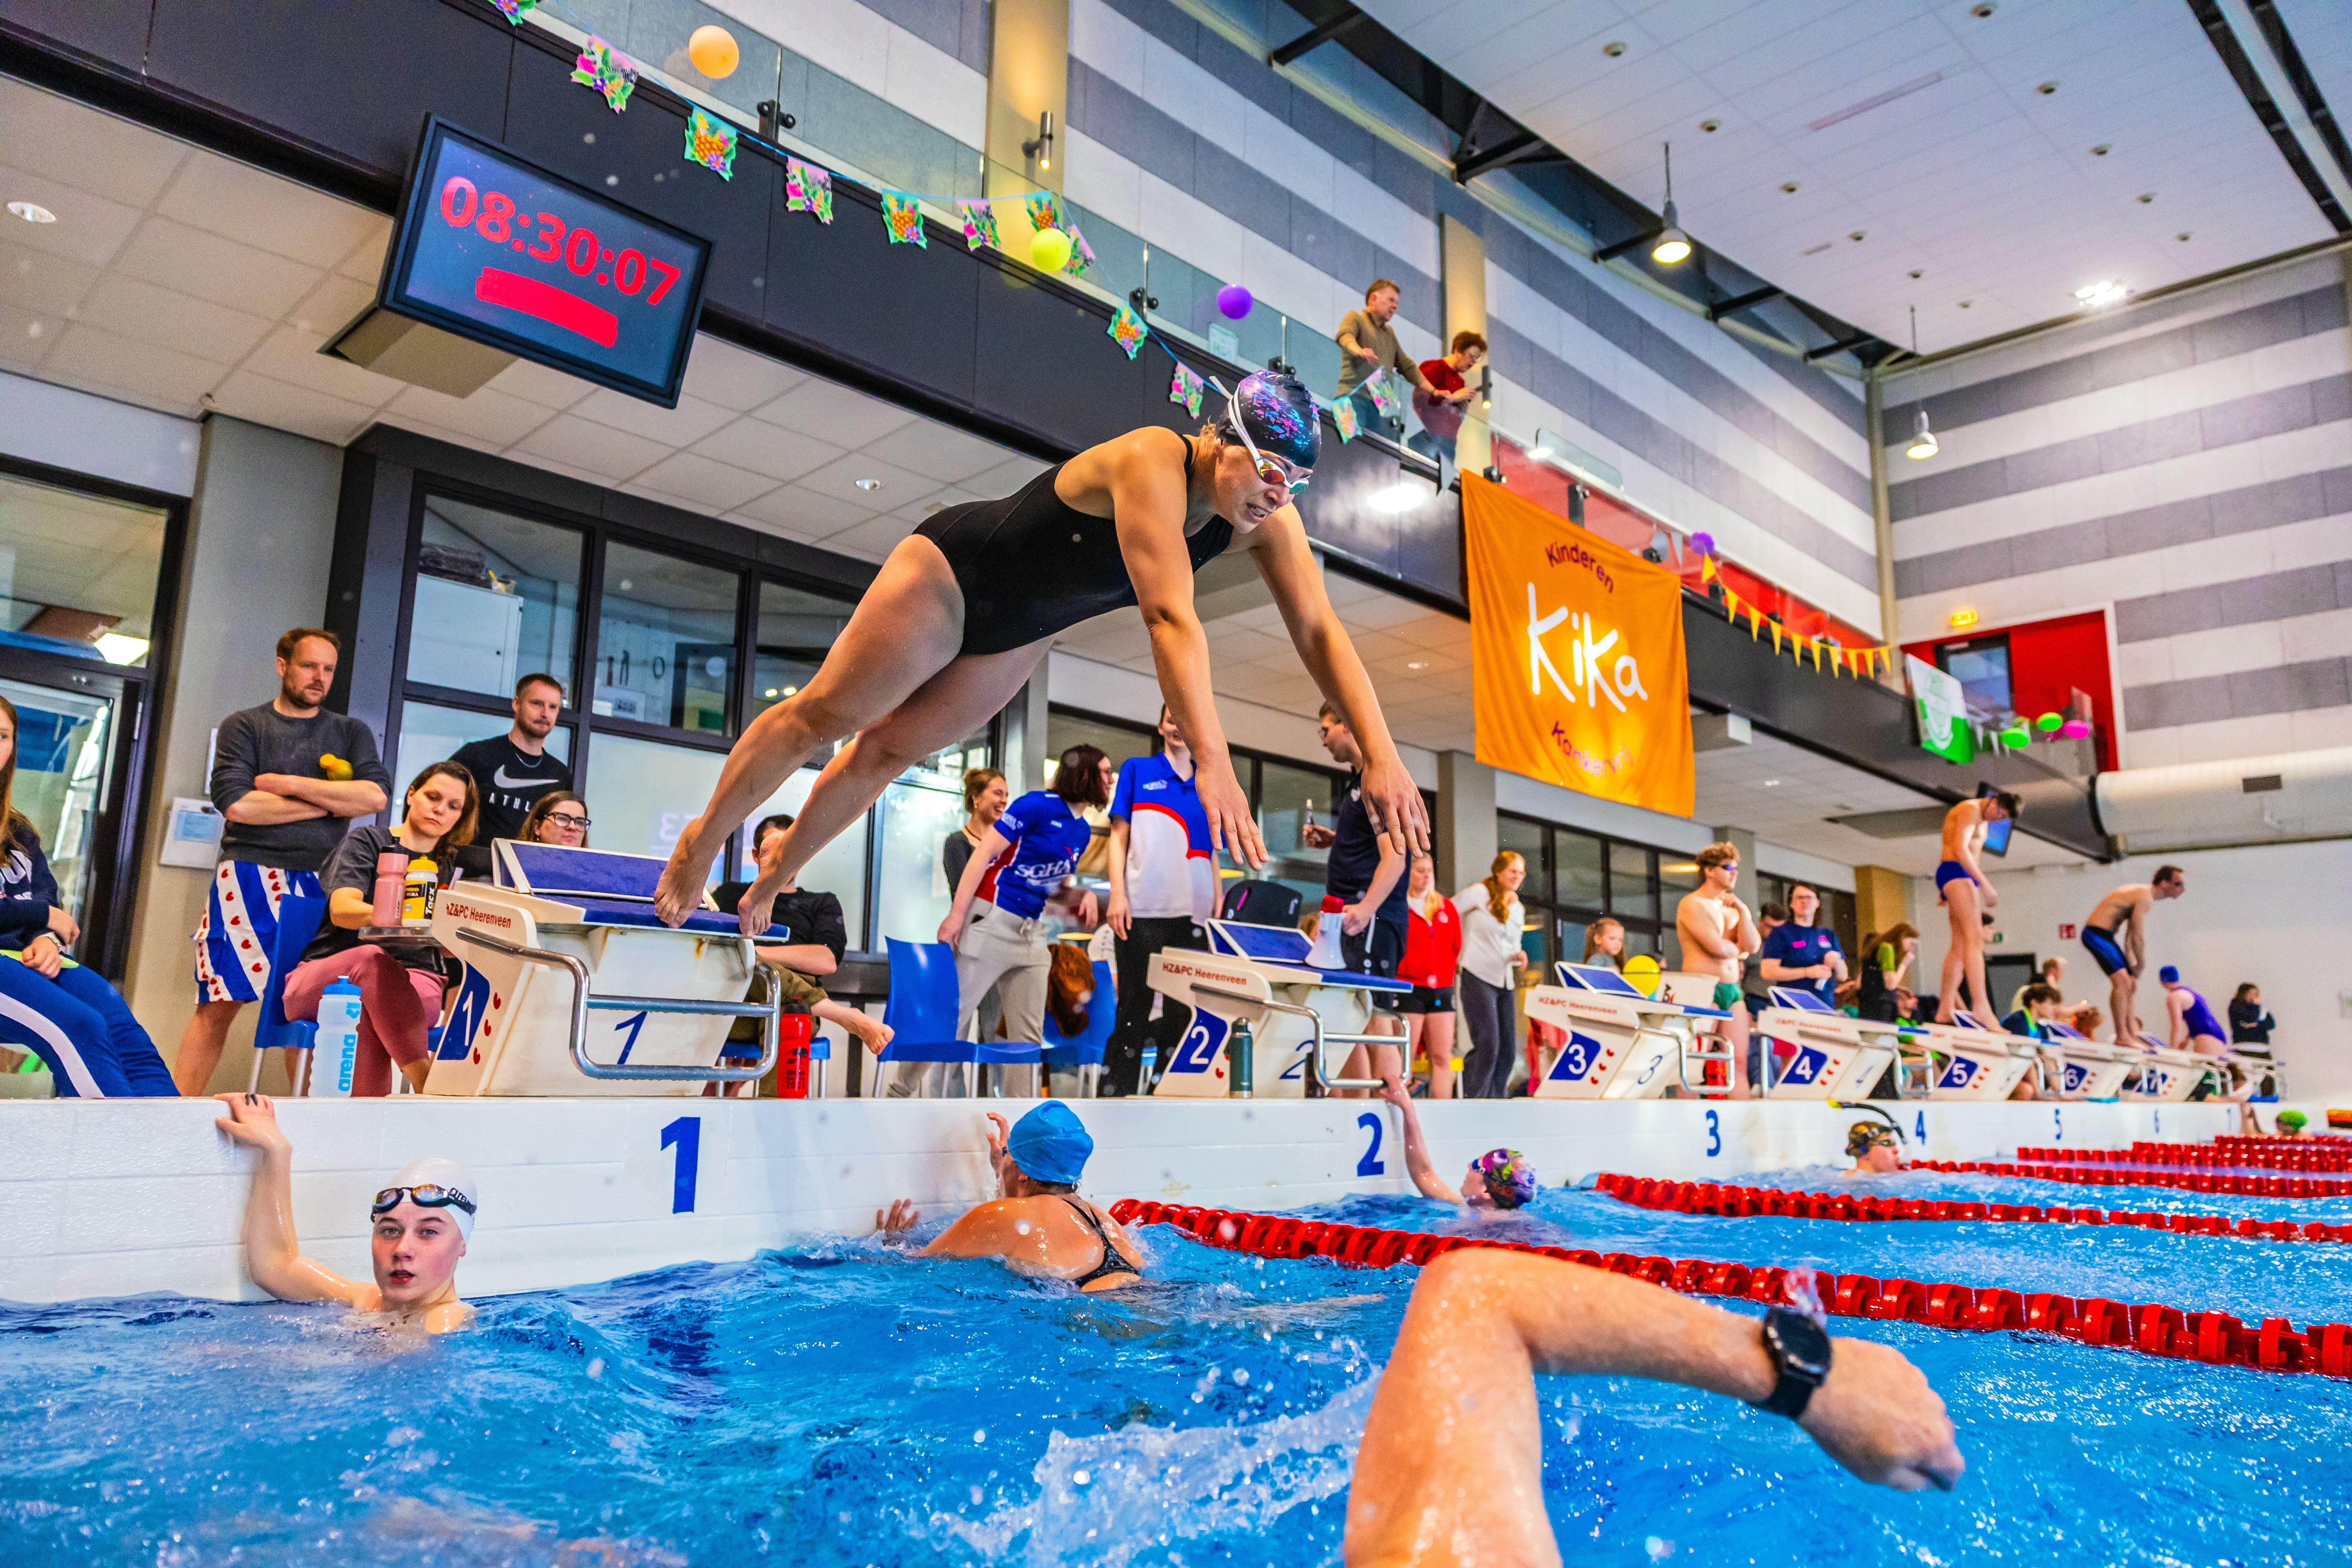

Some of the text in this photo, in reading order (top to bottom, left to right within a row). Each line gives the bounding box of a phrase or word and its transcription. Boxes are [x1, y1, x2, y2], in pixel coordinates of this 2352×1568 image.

[441, 176, 681, 305] 08:30:07
[1545, 541, 1614, 593] Kinderen
[1551, 720, 1634, 777] Kankervrij
[425, 887, 435, 915] Tacx
[470, 907, 511, 929] Heerenveen
[1163, 963, 1246, 985] HZ&PC Heerenveen
[463, 991, 474, 1046] 1
[614, 1011, 647, 1065] 1
[1190, 1025, 1209, 1064] 2
[338, 1034, 356, 1091] arena
[1568, 1044, 1586, 1074] 3
[1638, 1055, 1662, 1084] 3
[1795, 1055, 1813, 1080] 4
[1953, 1063, 1967, 1084] 5
[2065, 1068, 2078, 1087] 6
[1705, 1109, 1722, 1158] 3
[1915, 1109, 1927, 1145] 4
[2054, 1108, 2063, 1142] 5
[1356, 1112, 1385, 1178] 2
[660, 1116, 701, 1214] 1
[449, 1187, 467, 1203] are
